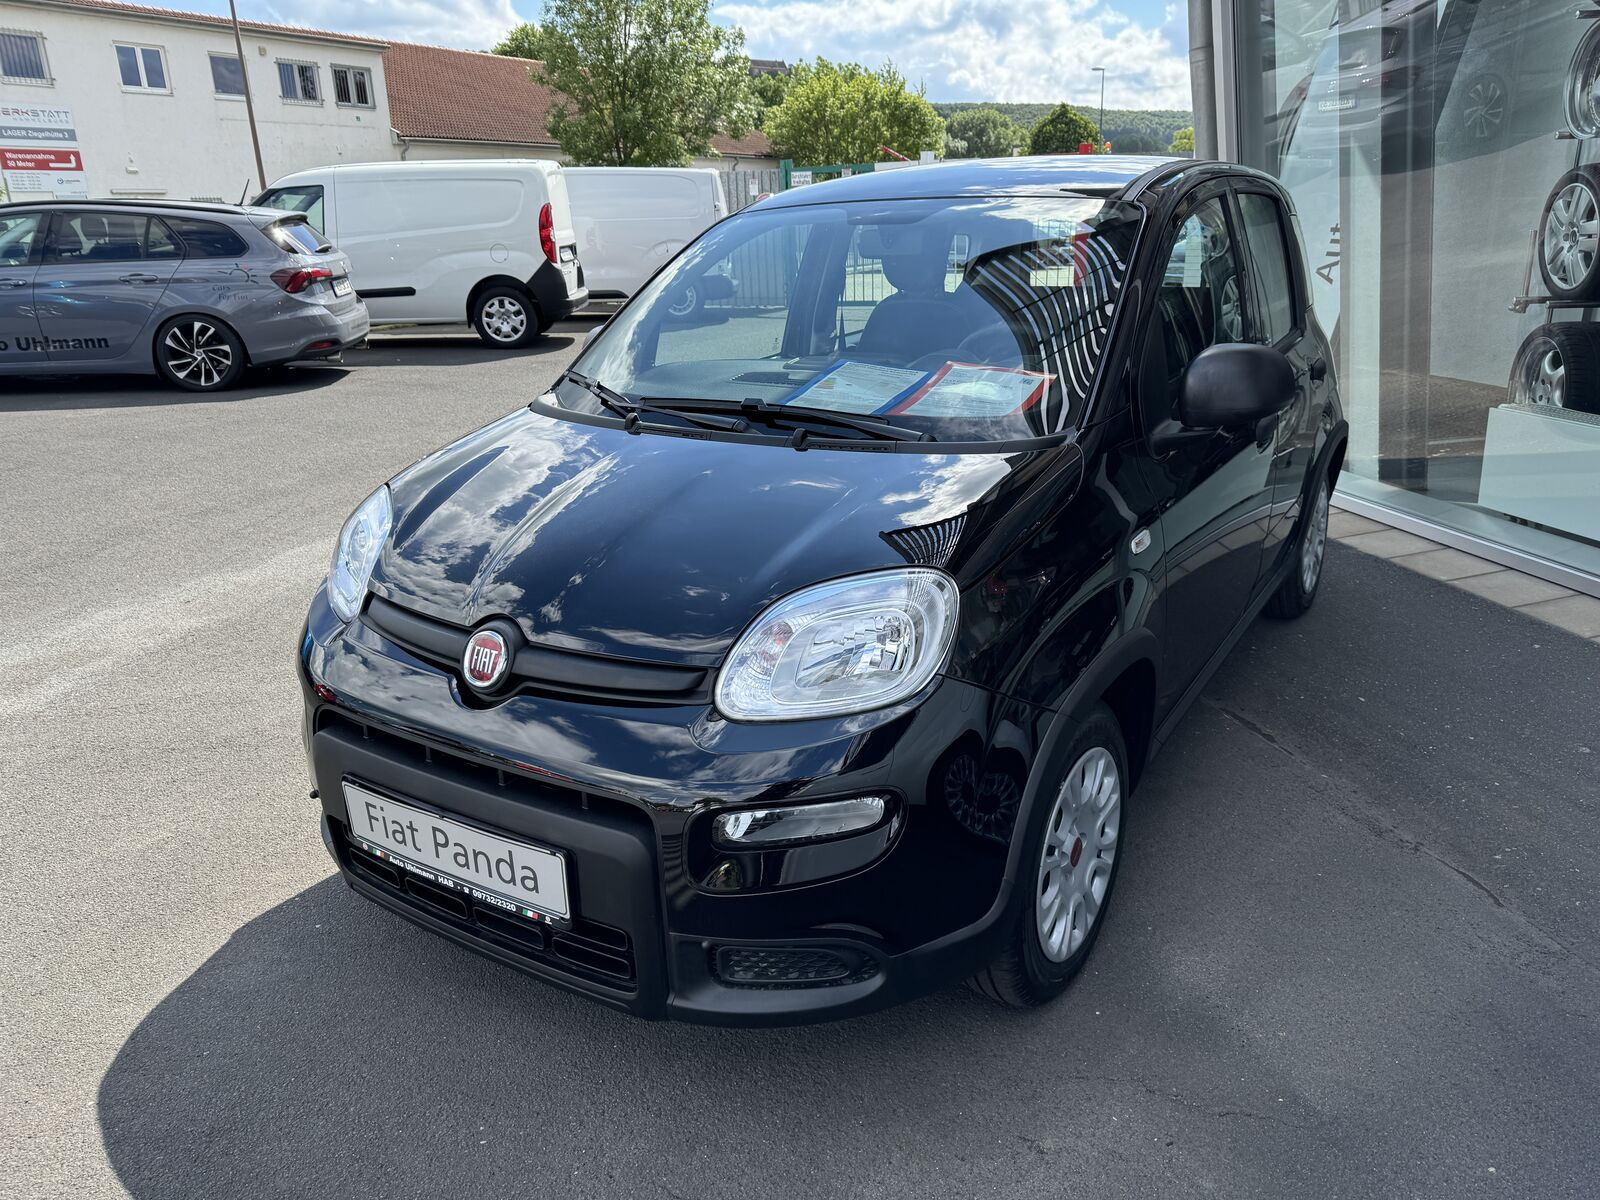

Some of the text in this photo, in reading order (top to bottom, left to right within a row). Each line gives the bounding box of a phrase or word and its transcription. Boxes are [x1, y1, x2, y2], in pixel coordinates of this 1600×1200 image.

[0, 107, 70, 119] ERKSTATT
[1, 128, 27, 137] LAGER
[4, 151, 56, 160] Warenannahme
[7, 160, 16, 168] 50
[14, 335, 110, 352] Uhlmann
[471, 645, 499, 674] FIAT
[364, 801, 540, 894] Fiat Panda
[389, 855, 517, 913] Auto Uhlmann HAB 09732/2320
